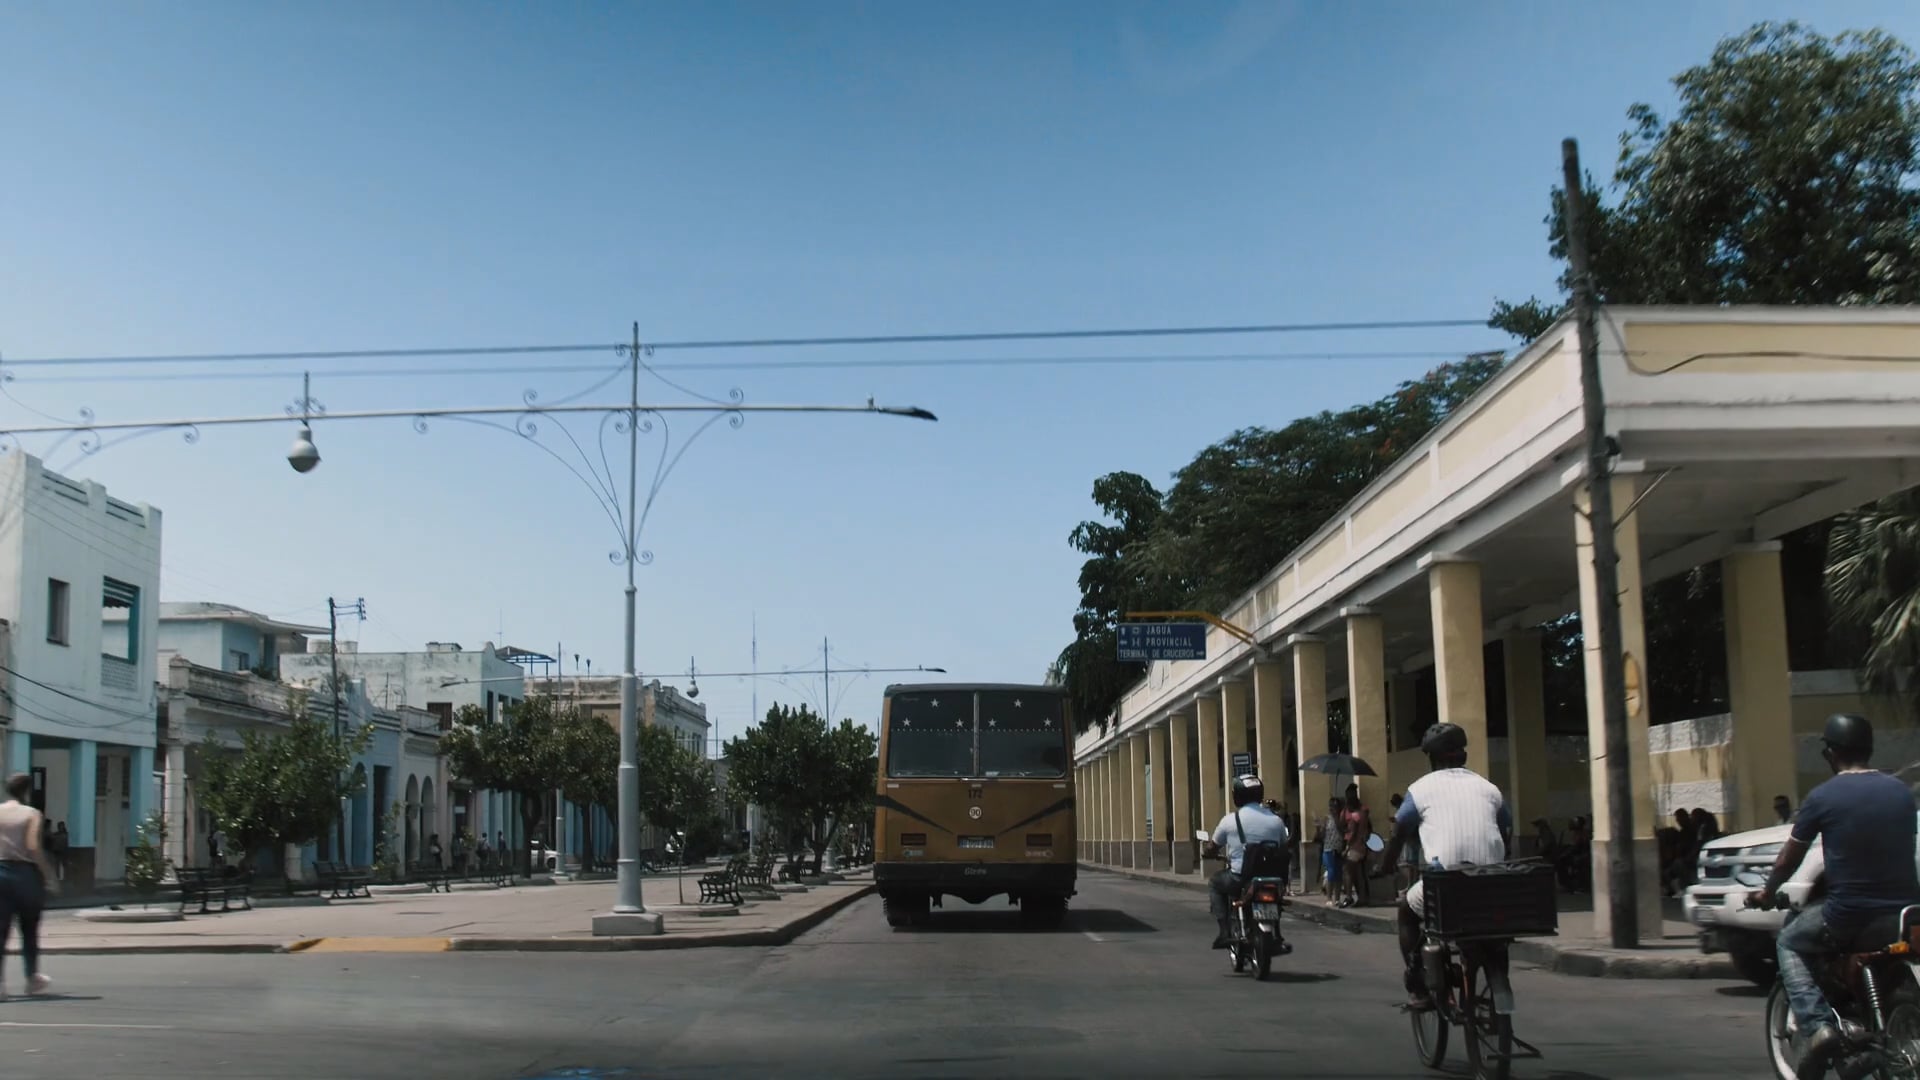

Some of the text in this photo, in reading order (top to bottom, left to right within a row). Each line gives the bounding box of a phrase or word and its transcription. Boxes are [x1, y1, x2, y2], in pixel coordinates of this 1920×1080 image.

[1146, 626, 1171, 635] JAGUA
[1146, 637, 1192, 647] PROVINCIAL
[1120, 649, 1194, 658] TERMINAL DE CRUCEROS
